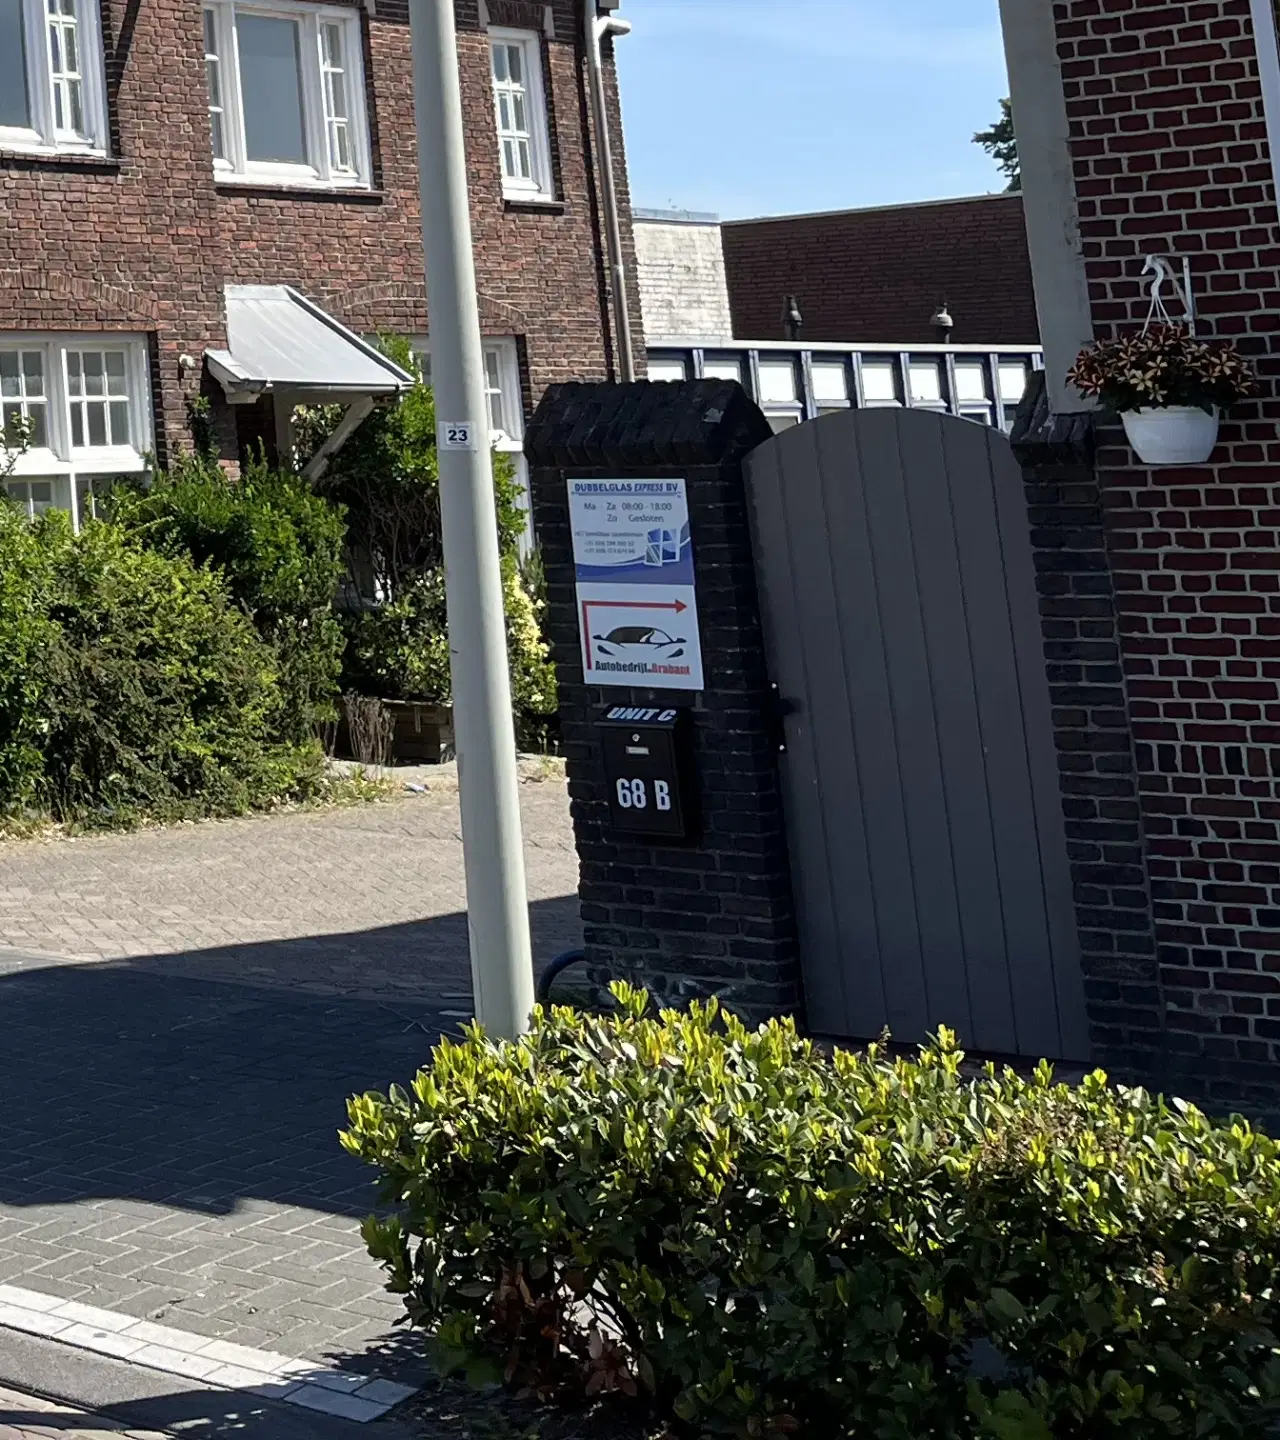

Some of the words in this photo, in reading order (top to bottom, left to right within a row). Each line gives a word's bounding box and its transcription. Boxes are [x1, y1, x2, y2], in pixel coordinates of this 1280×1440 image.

[448, 429, 467, 441] 23
[574, 483, 632, 492] DUBBELGLAS
[634, 483, 663, 492] EXPRESS
[666, 483, 678, 492] BV
[583, 502, 596, 510] Ma
[606, 502, 617, 510] Za
[621, 502, 644, 511] 08:00
[651, 502, 672, 511] 18:00
[628, 514, 664, 523] Gesloten
[606, 707, 660, 720] UNIT
[657, 709, 677, 721] C
[616, 778, 647, 808] 68
[654, 779, 671, 810] B
